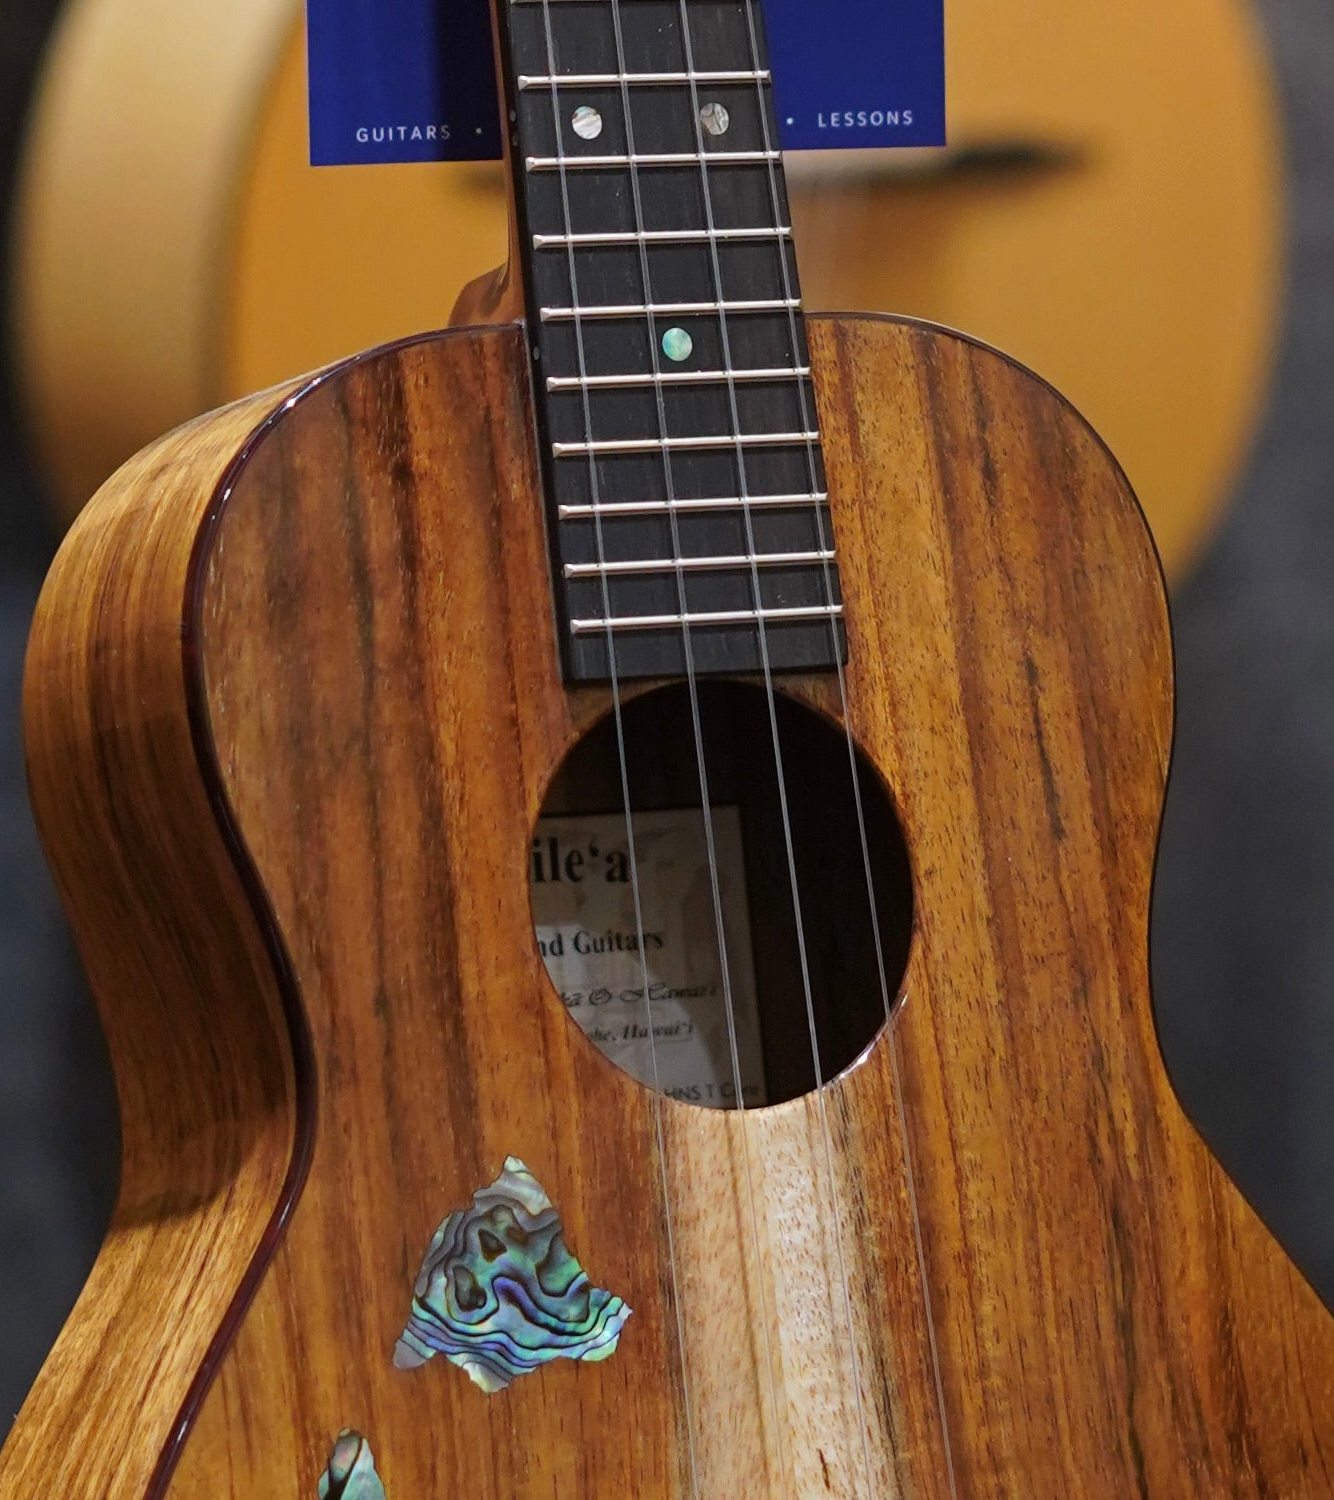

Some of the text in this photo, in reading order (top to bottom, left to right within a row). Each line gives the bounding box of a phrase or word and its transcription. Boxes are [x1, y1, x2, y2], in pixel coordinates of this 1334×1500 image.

[355, 109, 914, 143] GUITARS LESSONS
[572, 929, 665, 956] Guitars
